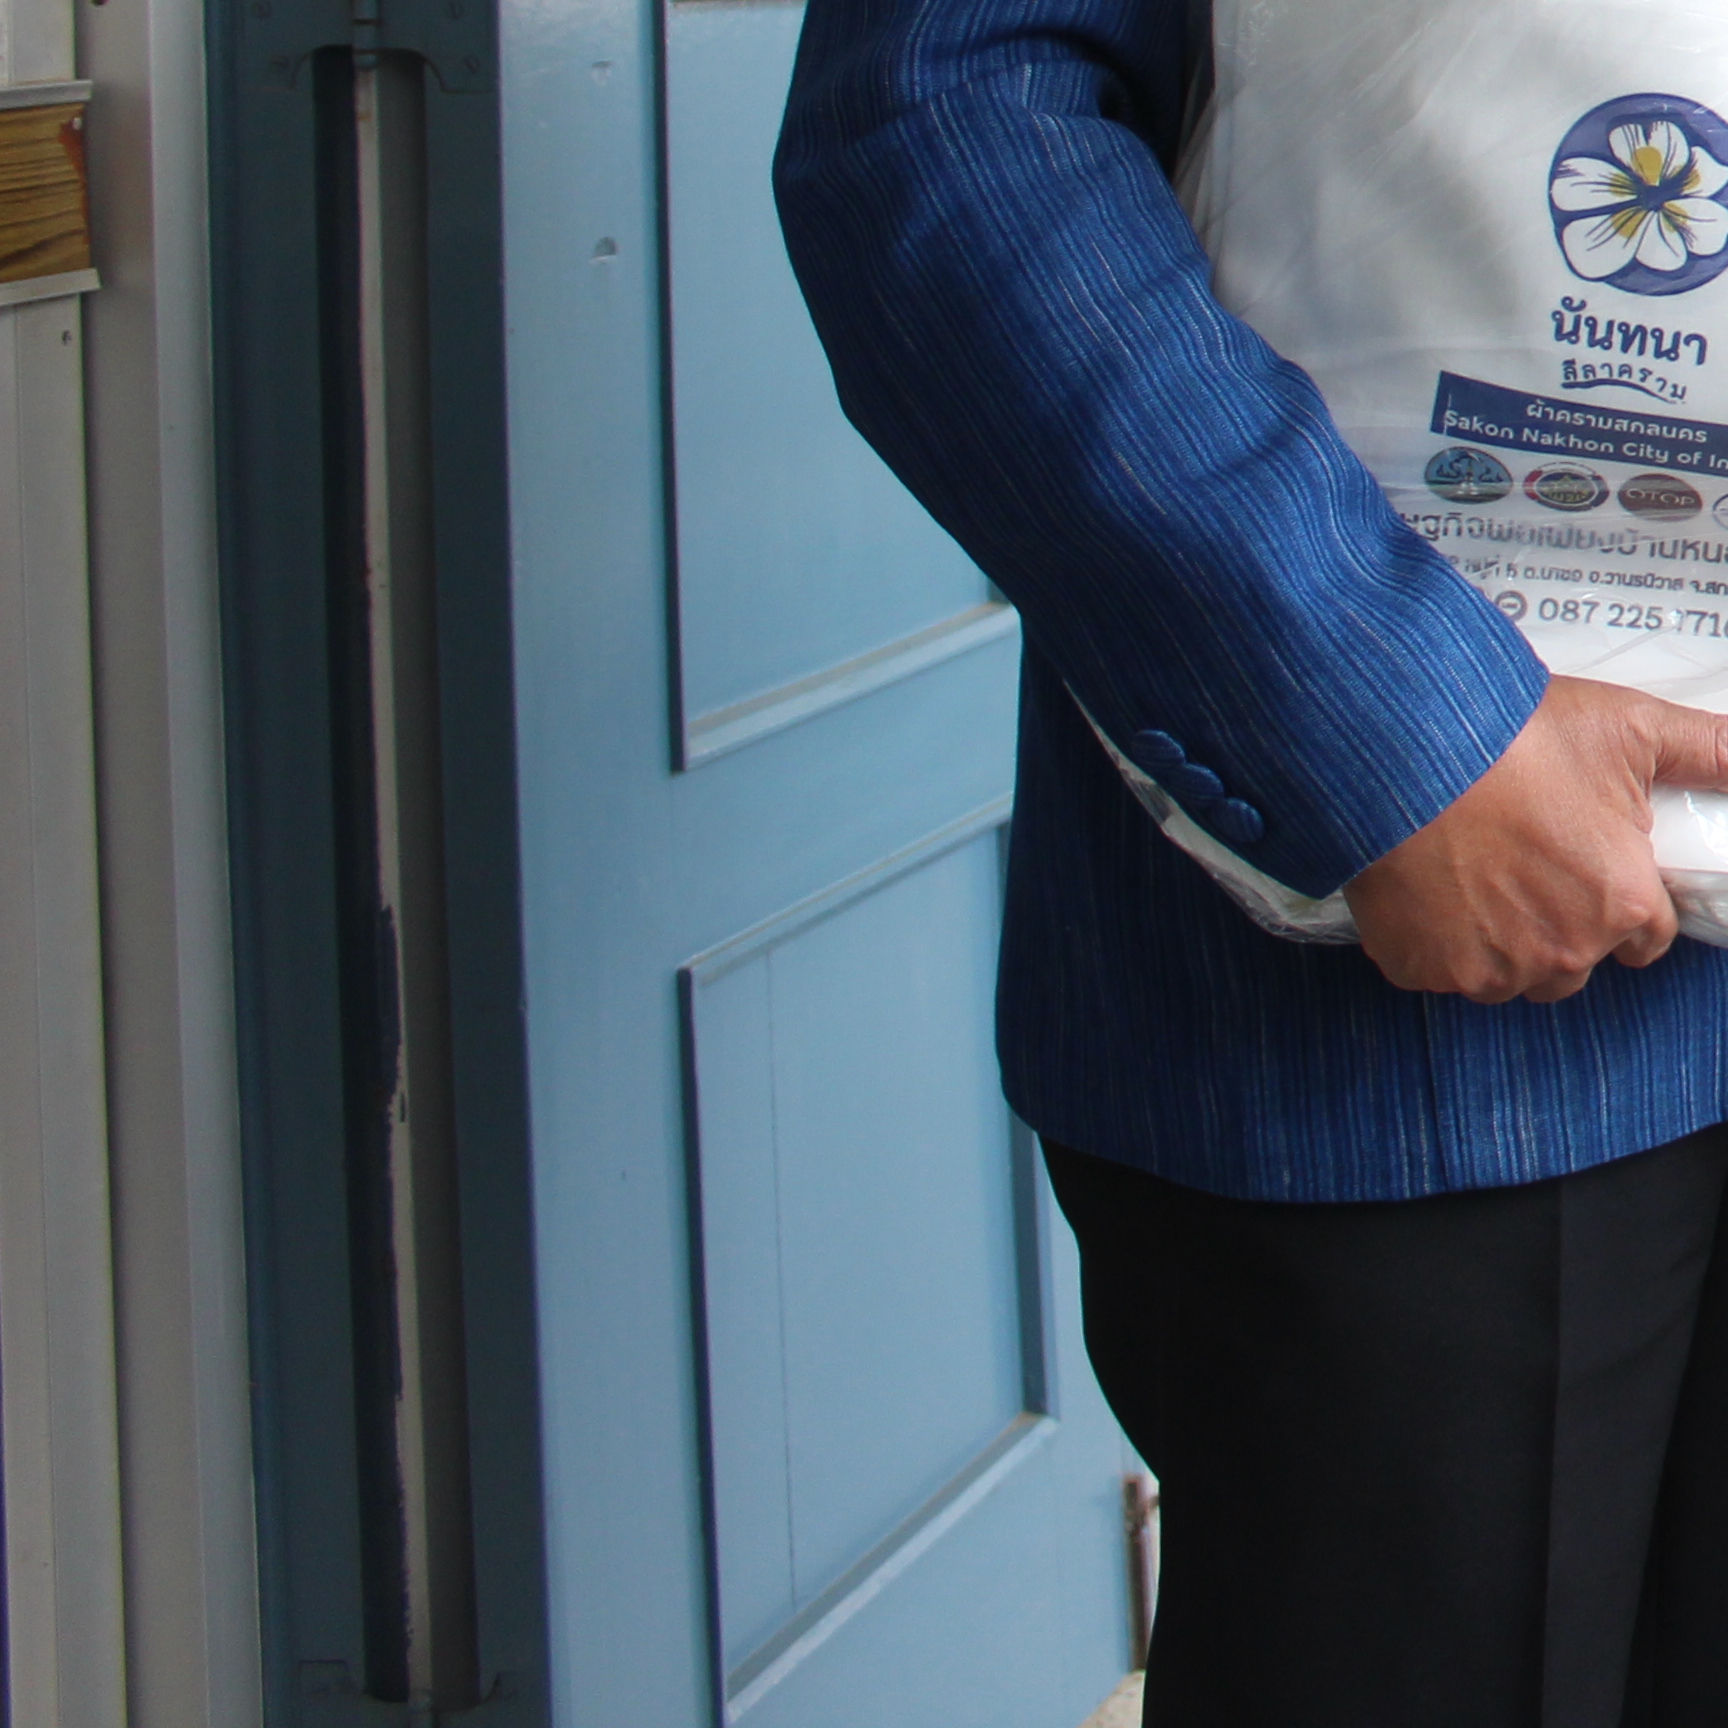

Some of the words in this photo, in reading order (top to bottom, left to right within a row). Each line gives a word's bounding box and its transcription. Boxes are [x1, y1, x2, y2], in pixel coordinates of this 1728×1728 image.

[1552, 296, 1707, 365] นันทนา
[1445, 410, 1514, 439] Sakon
[1522, 427, 1614, 453] Nakhon
[1622, 442, 1669, 463] City
[1677, 451, 1702, 465] of
[1526, 399, 1707, 444] ผ้าครามสกลนคร
[1626, 488, 1695, 506] OTOP
[1539, 597, 1600, 624] 087
[1607, 602, 1663, 630] 225
